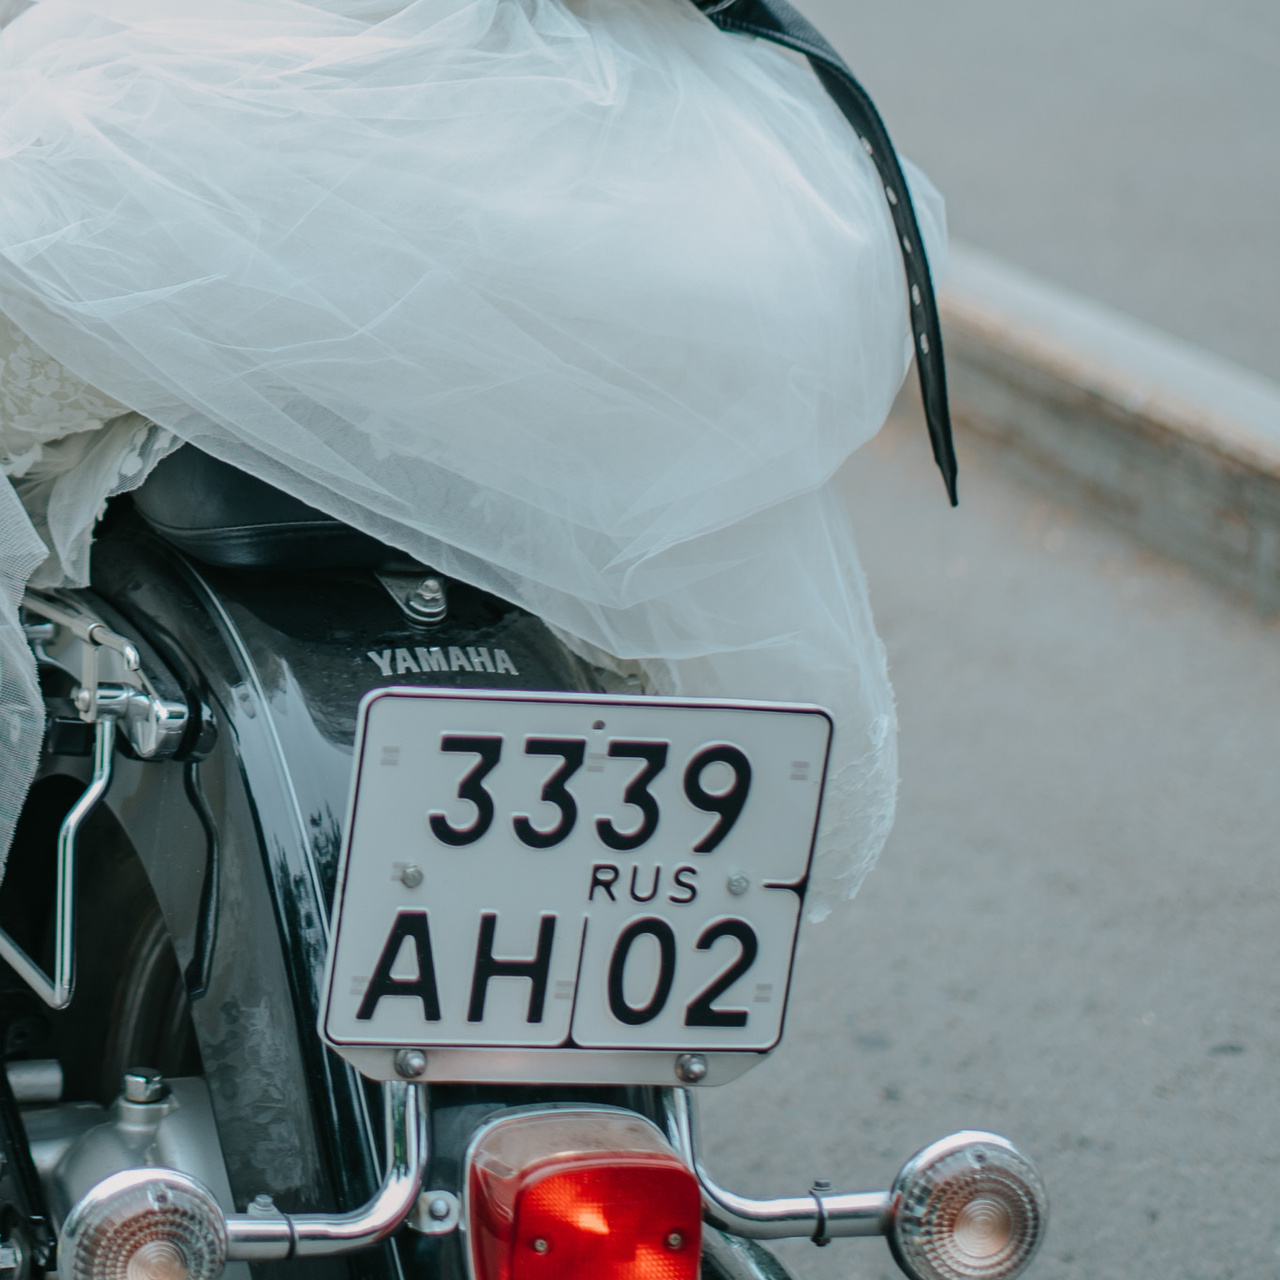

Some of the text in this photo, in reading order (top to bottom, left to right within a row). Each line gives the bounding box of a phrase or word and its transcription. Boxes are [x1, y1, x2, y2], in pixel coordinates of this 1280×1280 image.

[367, 646, 519, 676] YAMAHA
[428, 735, 752, 853] 3339
[588, 863, 698, 904] RUS
[356, 910, 758, 1027] AH 02
